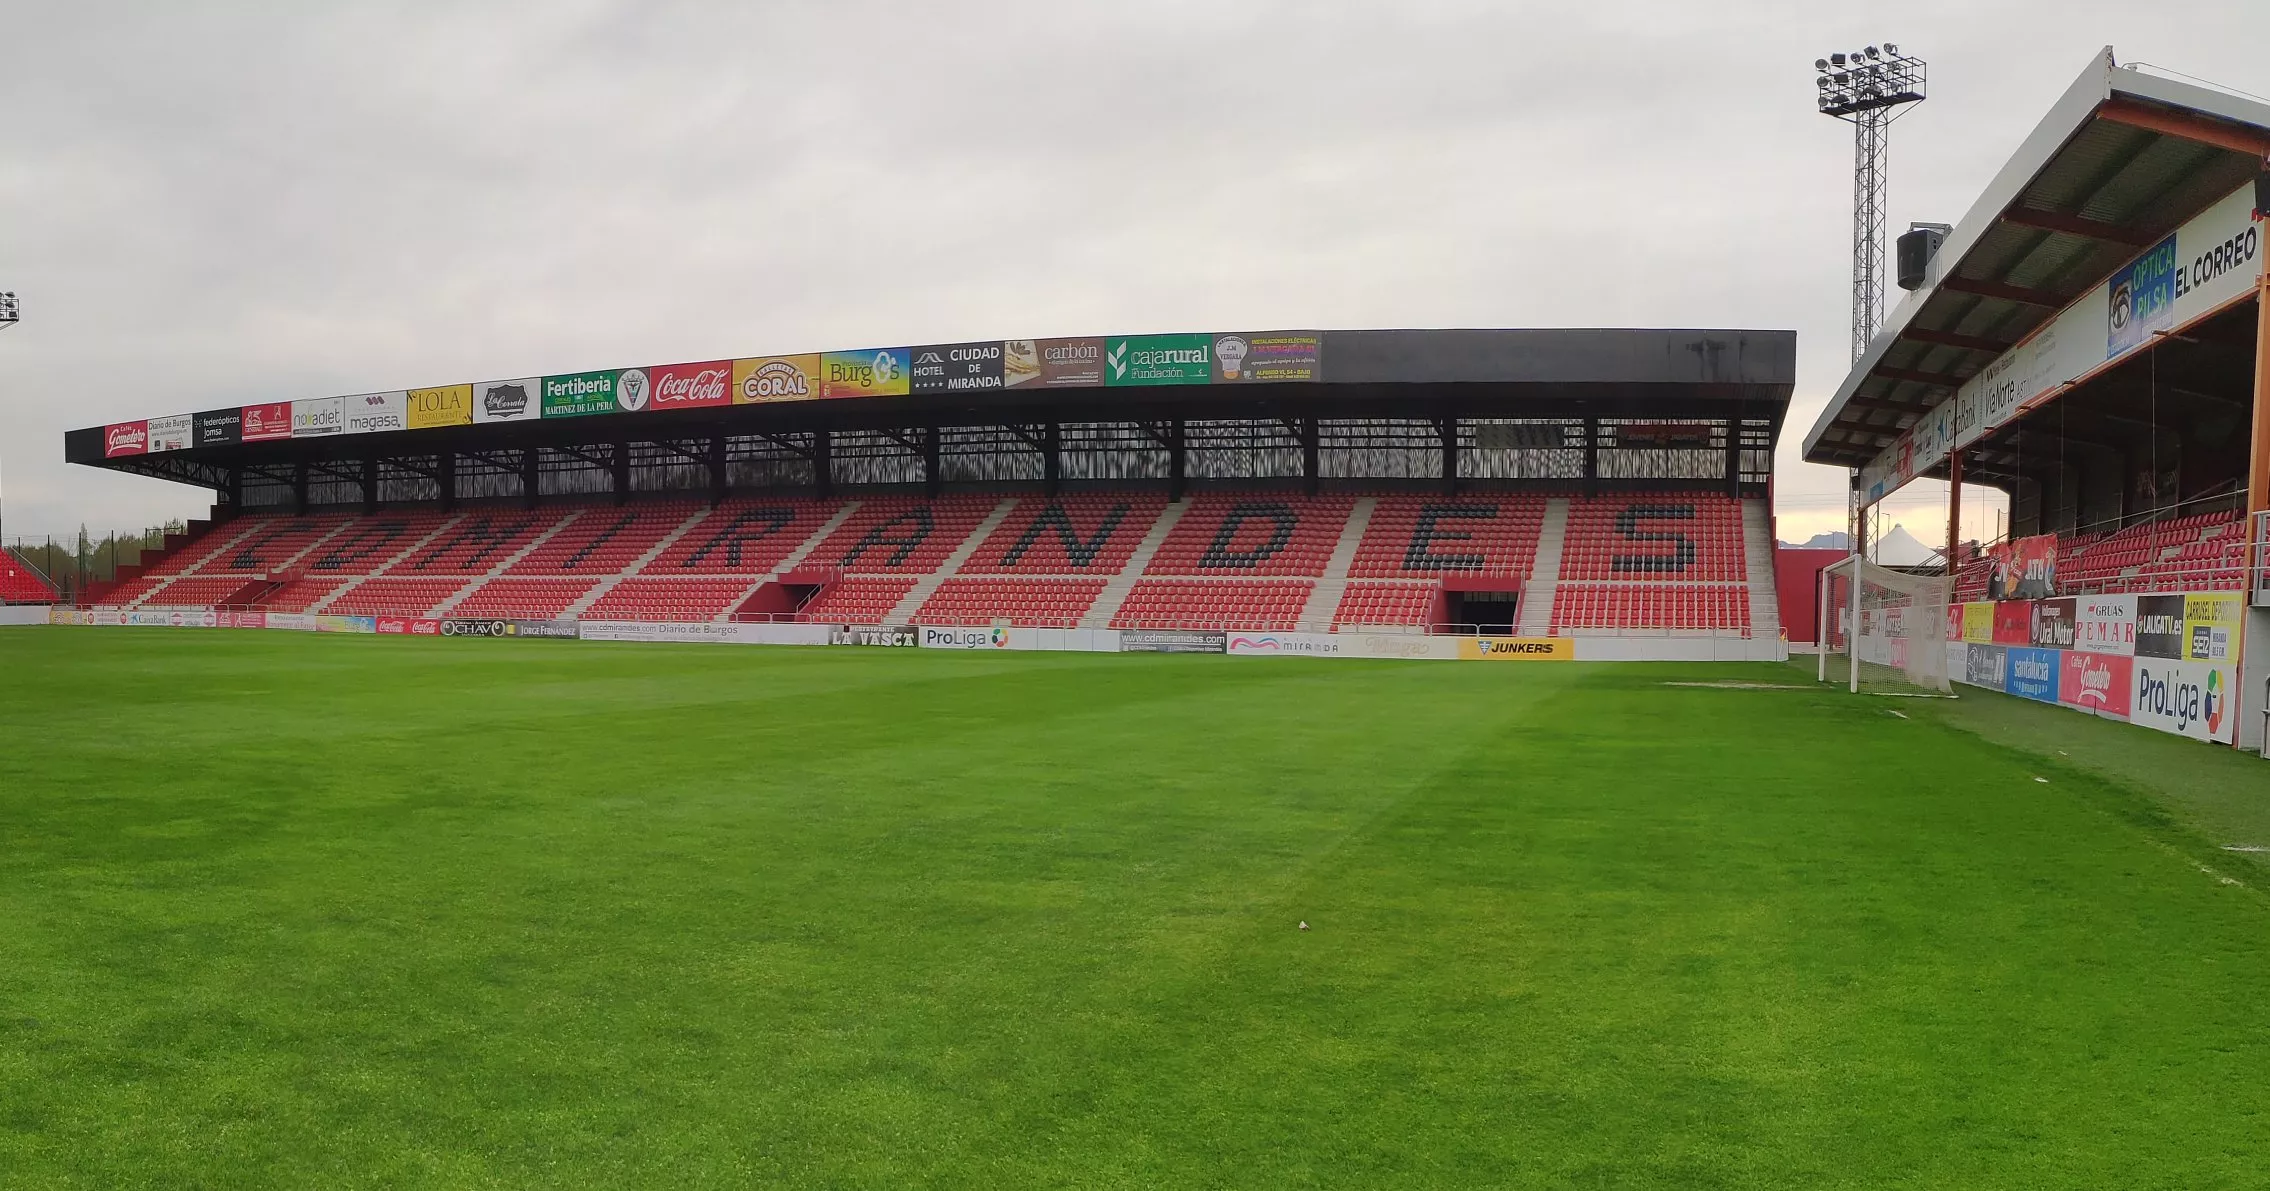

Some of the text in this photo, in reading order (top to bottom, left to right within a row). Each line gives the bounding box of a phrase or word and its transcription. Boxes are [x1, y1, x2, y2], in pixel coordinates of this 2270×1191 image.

[2133, 244, 2173, 291] OPTICA
[2175, 226, 2257, 299] EL CORREO
[2137, 282, 2168, 321] PILSA
[950, 347, 1000, 361] CIUDAD
[1044, 342, 1099, 360] carbón
[1131, 345, 1209, 369] cajarural
[913, 366, 944, 377] HOTEL
[968, 364, 981, 373] DE
[1131, 366, 1184, 379] Fundación
[547, 376, 611, 397] Fertiberia
[655, 369, 730, 402] Coca-Cola
[744, 373, 807, 397] CORAL
[948, 376, 1002, 390] MIRANDA
[418, 391, 461, 412] LOLA
[576, 404, 586, 413] DE
[587, 403, 595, 412] LA
[149, 418, 191, 430] Diario de Burgos
[204, 415, 240, 427] federópticos
[417, 411, 462, 421] RESTAURANTE
[2095, 603, 2124, 617] GRÚAS
[441, 619, 506, 637] OCHAVO
[521, 623, 577, 636] JORGE FERNÁNDEZ
[582, 623, 657, 632] www.cdmirandes.com
[659, 624, 686, 634] Diario
[689, 624, 700, 634] de
[2040, 622, 2053, 644] Ural
[2053, 622, 2074, 645] Motor
[2075, 621, 2134, 643] PEMAR
[2143, 615, 2182, 635] LALIGATV.es
[832, 631, 915, 647] LA VASCA
[927, 629, 986, 648] ProLiga
[1121, 634, 1225, 644] www.cdmirandes.com
[1491, 643, 1554, 654] JUNKERS
[2014, 652, 2049, 682] santalucía
[2139, 668, 2199, 731] ProLiga
